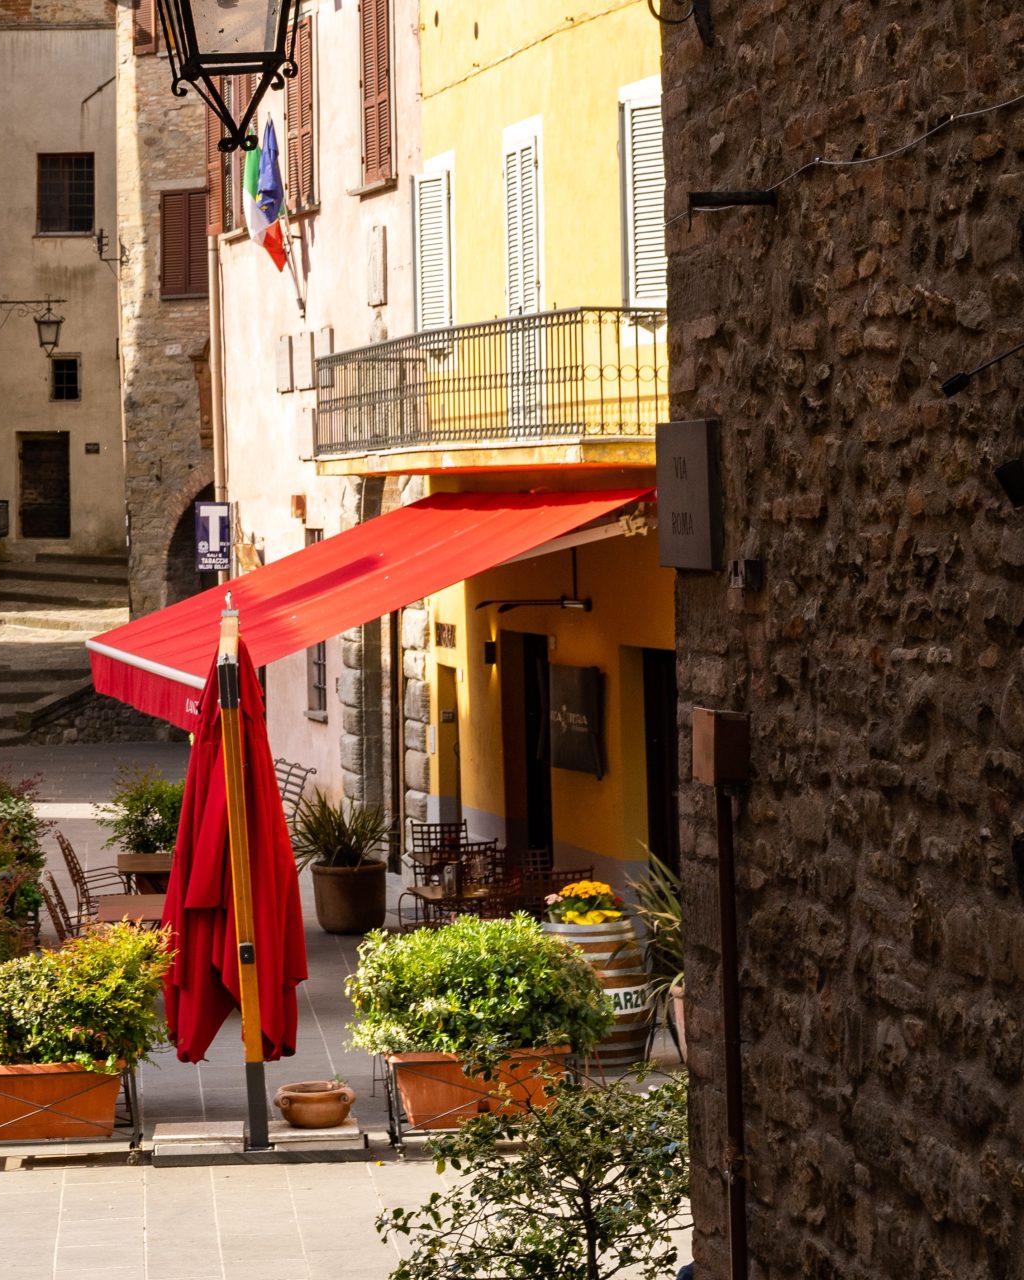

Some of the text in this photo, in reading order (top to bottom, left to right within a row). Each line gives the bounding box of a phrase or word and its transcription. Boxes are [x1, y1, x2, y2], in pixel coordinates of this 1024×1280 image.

[673, 456, 688, 480] VIA
[199, 505, 228, 552] T
[671, 511, 694, 536] ROMA
